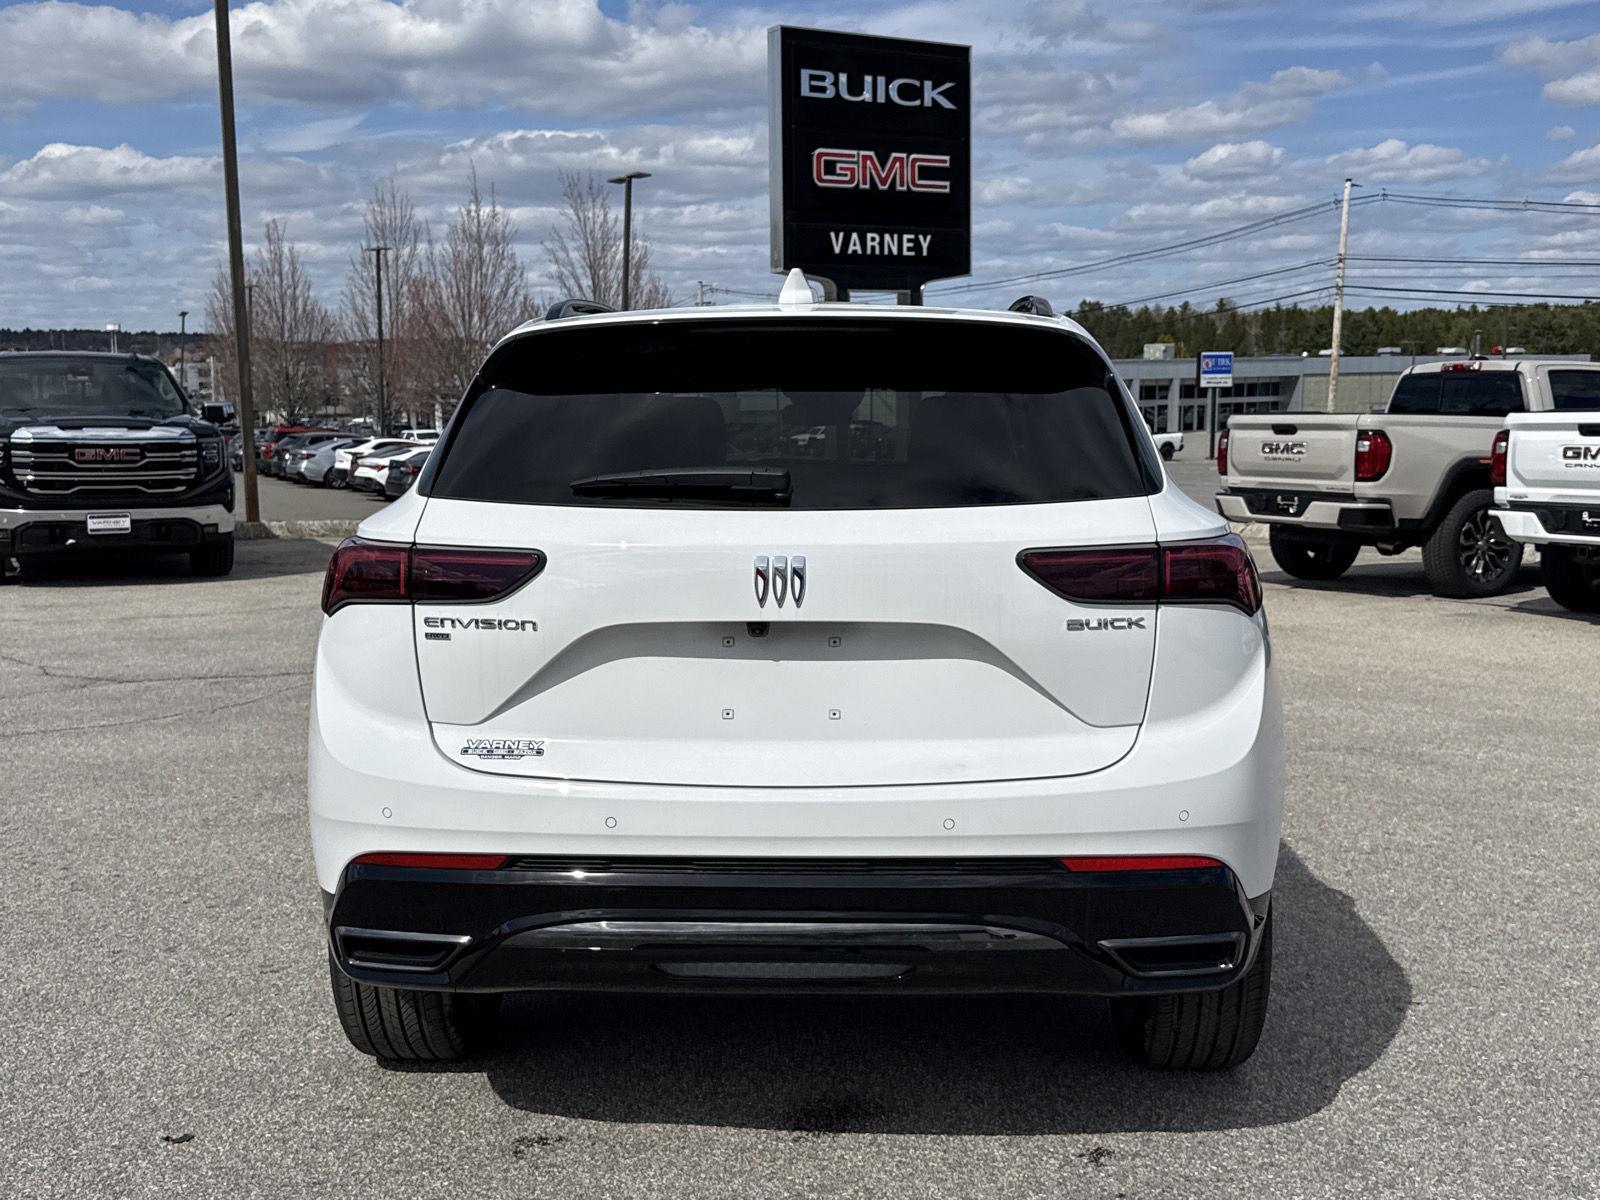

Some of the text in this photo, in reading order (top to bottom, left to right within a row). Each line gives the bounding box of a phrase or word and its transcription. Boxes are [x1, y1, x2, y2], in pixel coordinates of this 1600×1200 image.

[800, 68, 957, 110] BUICK
[813, 147, 951, 193] GMC
[830, 231, 932, 257] VARNEY
[75, 448, 140, 461] GMC
[1261, 442, 1307, 455] GMC
[92, 519, 127, 527] VARNEY
[1066, 616, 1147, 632] BUICK
[466, 738, 545, 750] VARNEY
